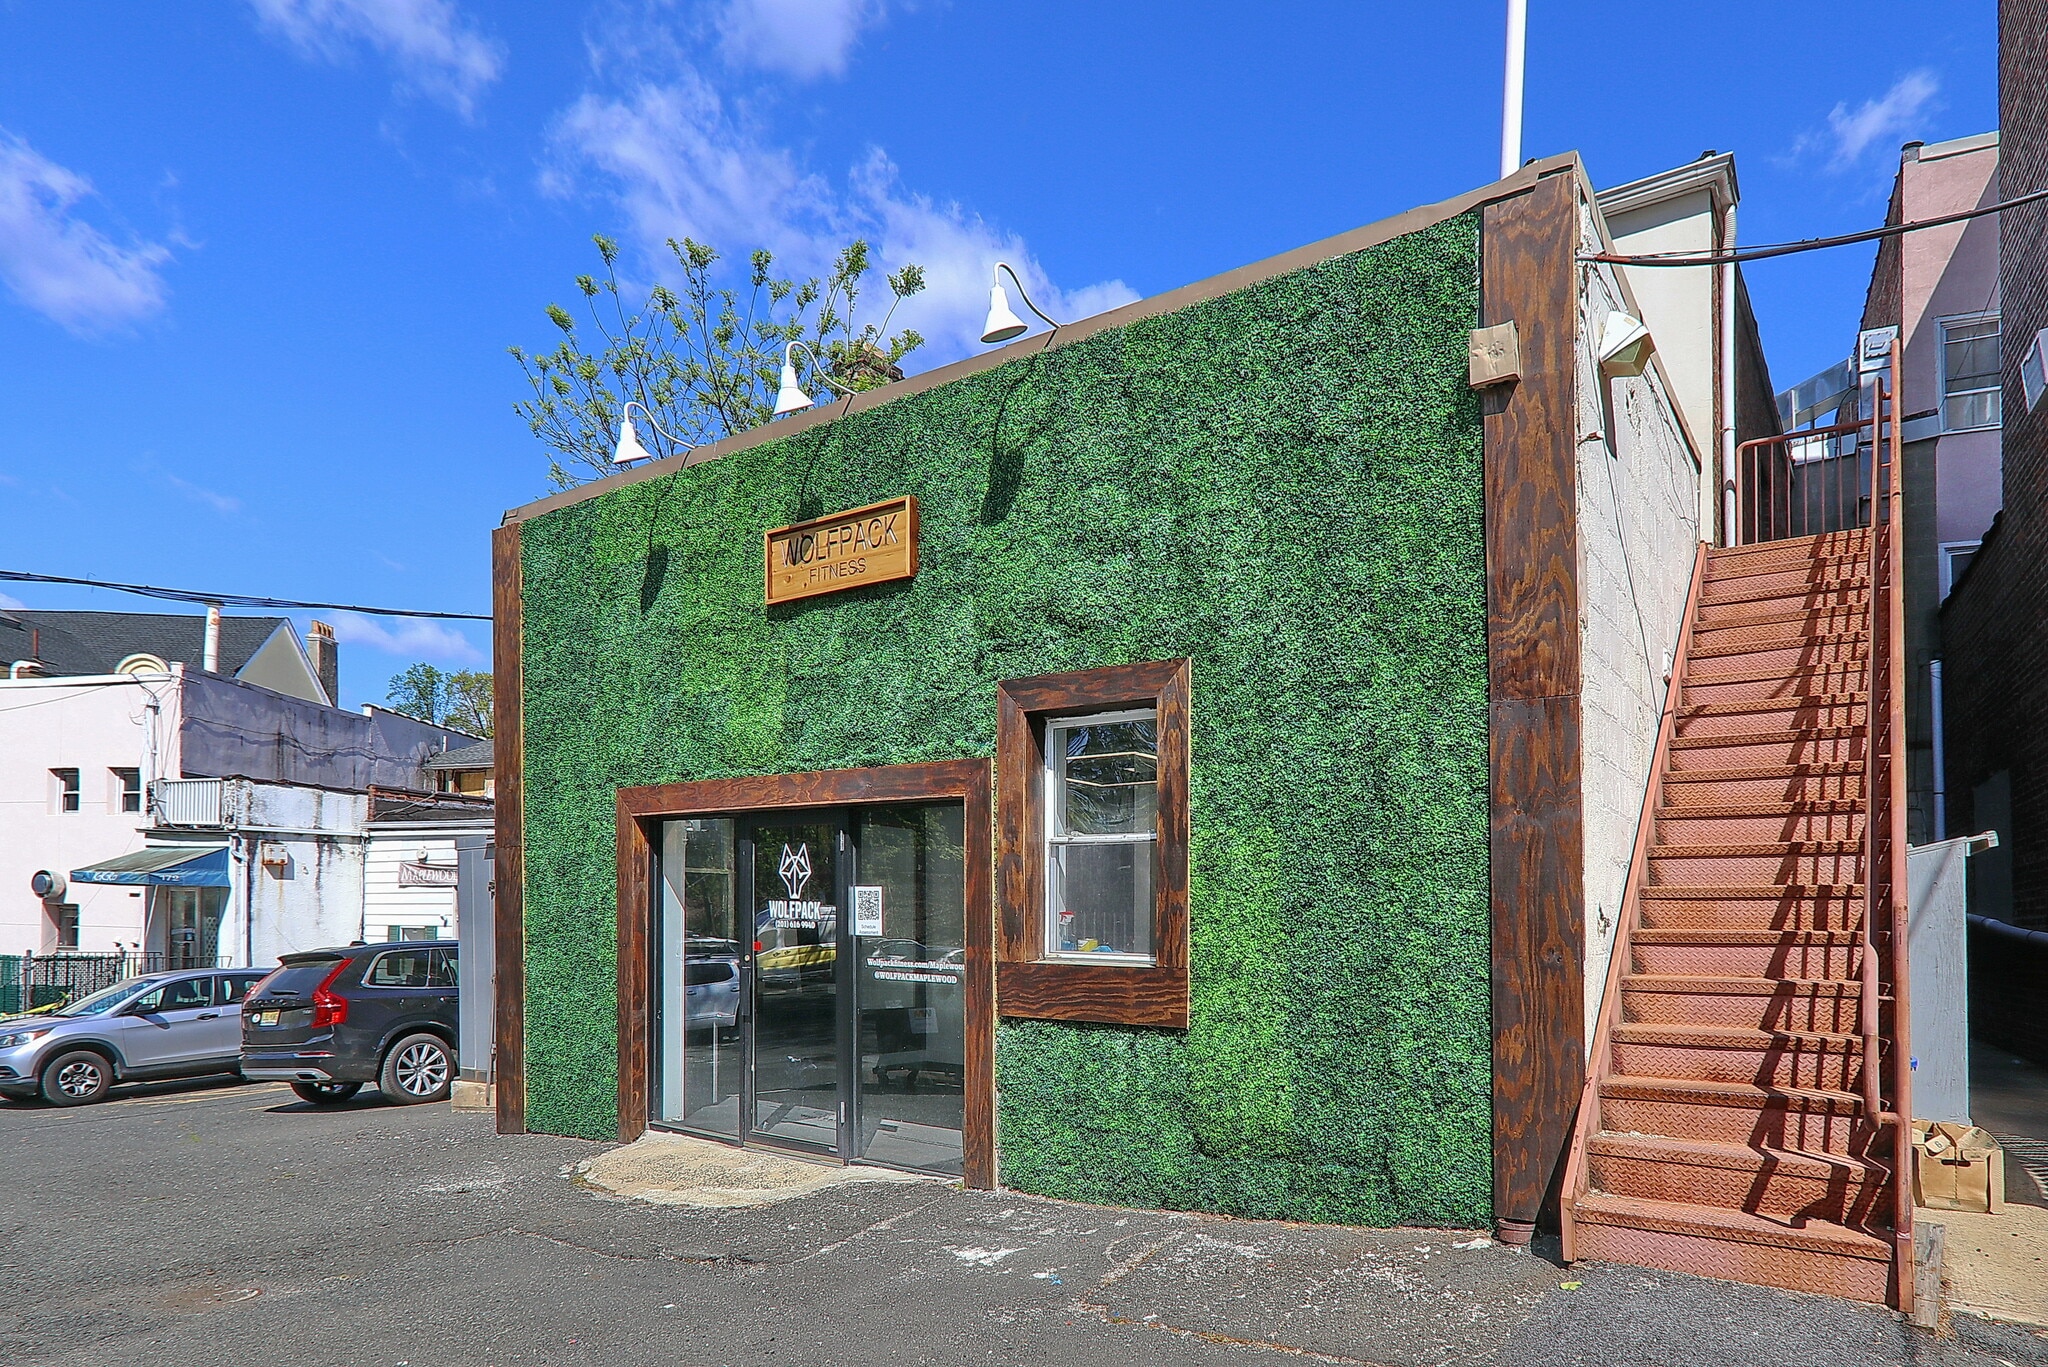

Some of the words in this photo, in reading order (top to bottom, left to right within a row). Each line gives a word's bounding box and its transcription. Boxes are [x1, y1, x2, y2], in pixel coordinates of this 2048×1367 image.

[780, 513, 899, 568] WOLFPACK
[809, 557, 867, 584] FITNESS
[768, 900, 821, 920] WOLFPACK
[874, 971, 958, 984] @WOLFPACKMAPLEWOOD
